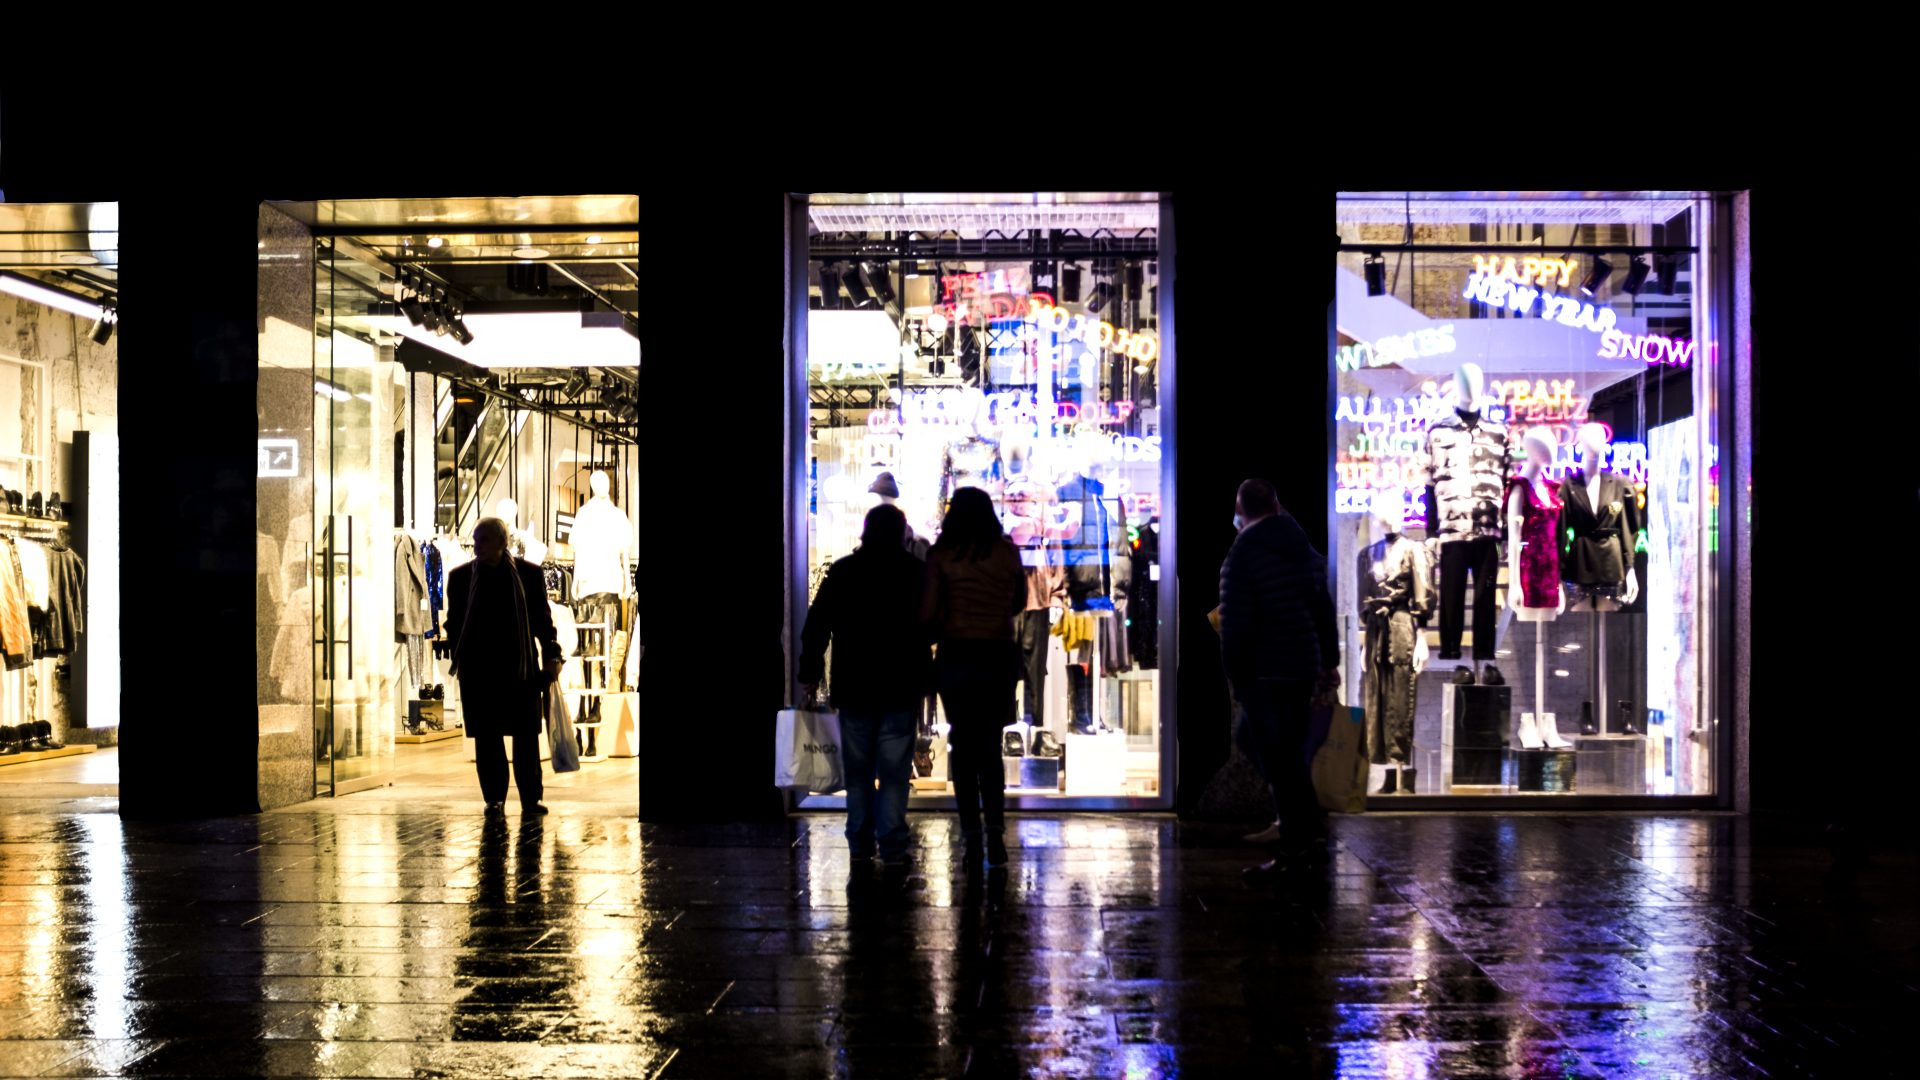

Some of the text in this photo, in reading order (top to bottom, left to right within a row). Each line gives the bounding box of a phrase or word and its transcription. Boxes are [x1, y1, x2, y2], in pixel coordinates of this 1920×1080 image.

[941, 268, 1027, 300] FELIZ
[1473, 255, 1578, 287] HAPPY
[1463, 273, 1618, 333] NEW YEAR
[1598, 329, 1699, 367] SNOW
[1490, 378, 1577, 407] YEAH
[1335, 396, 1391, 422] ALL
[1508, 397, 1589, 423] FELIZ
